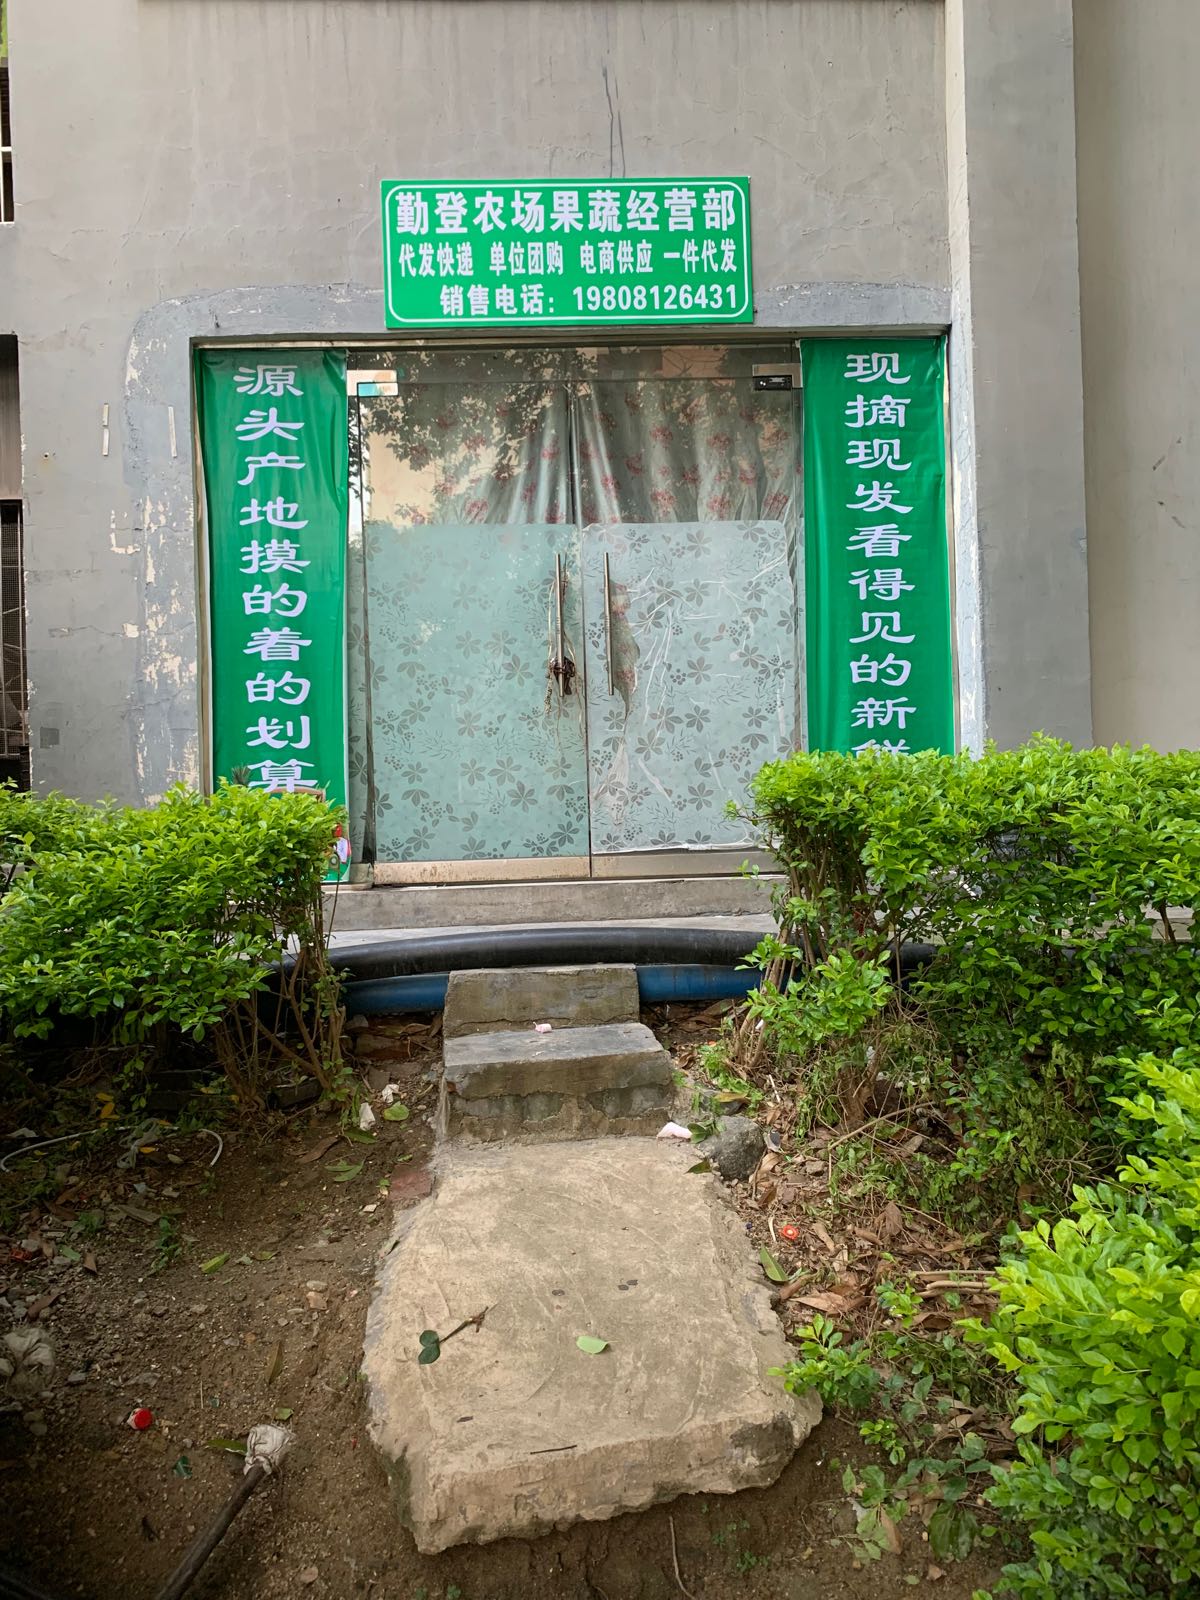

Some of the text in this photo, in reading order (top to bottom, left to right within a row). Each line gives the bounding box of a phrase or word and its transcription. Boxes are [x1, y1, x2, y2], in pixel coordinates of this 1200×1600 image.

[395, 188, 736, 235] 勤登农场果蔬经营部
[398, 238, 737, 278] 代发快递 单位团购 电商供应 一件代发
[572, 284, 737, 311] 19808126431
[233, 364, 318, 793] 源头产地摸的着的划算
